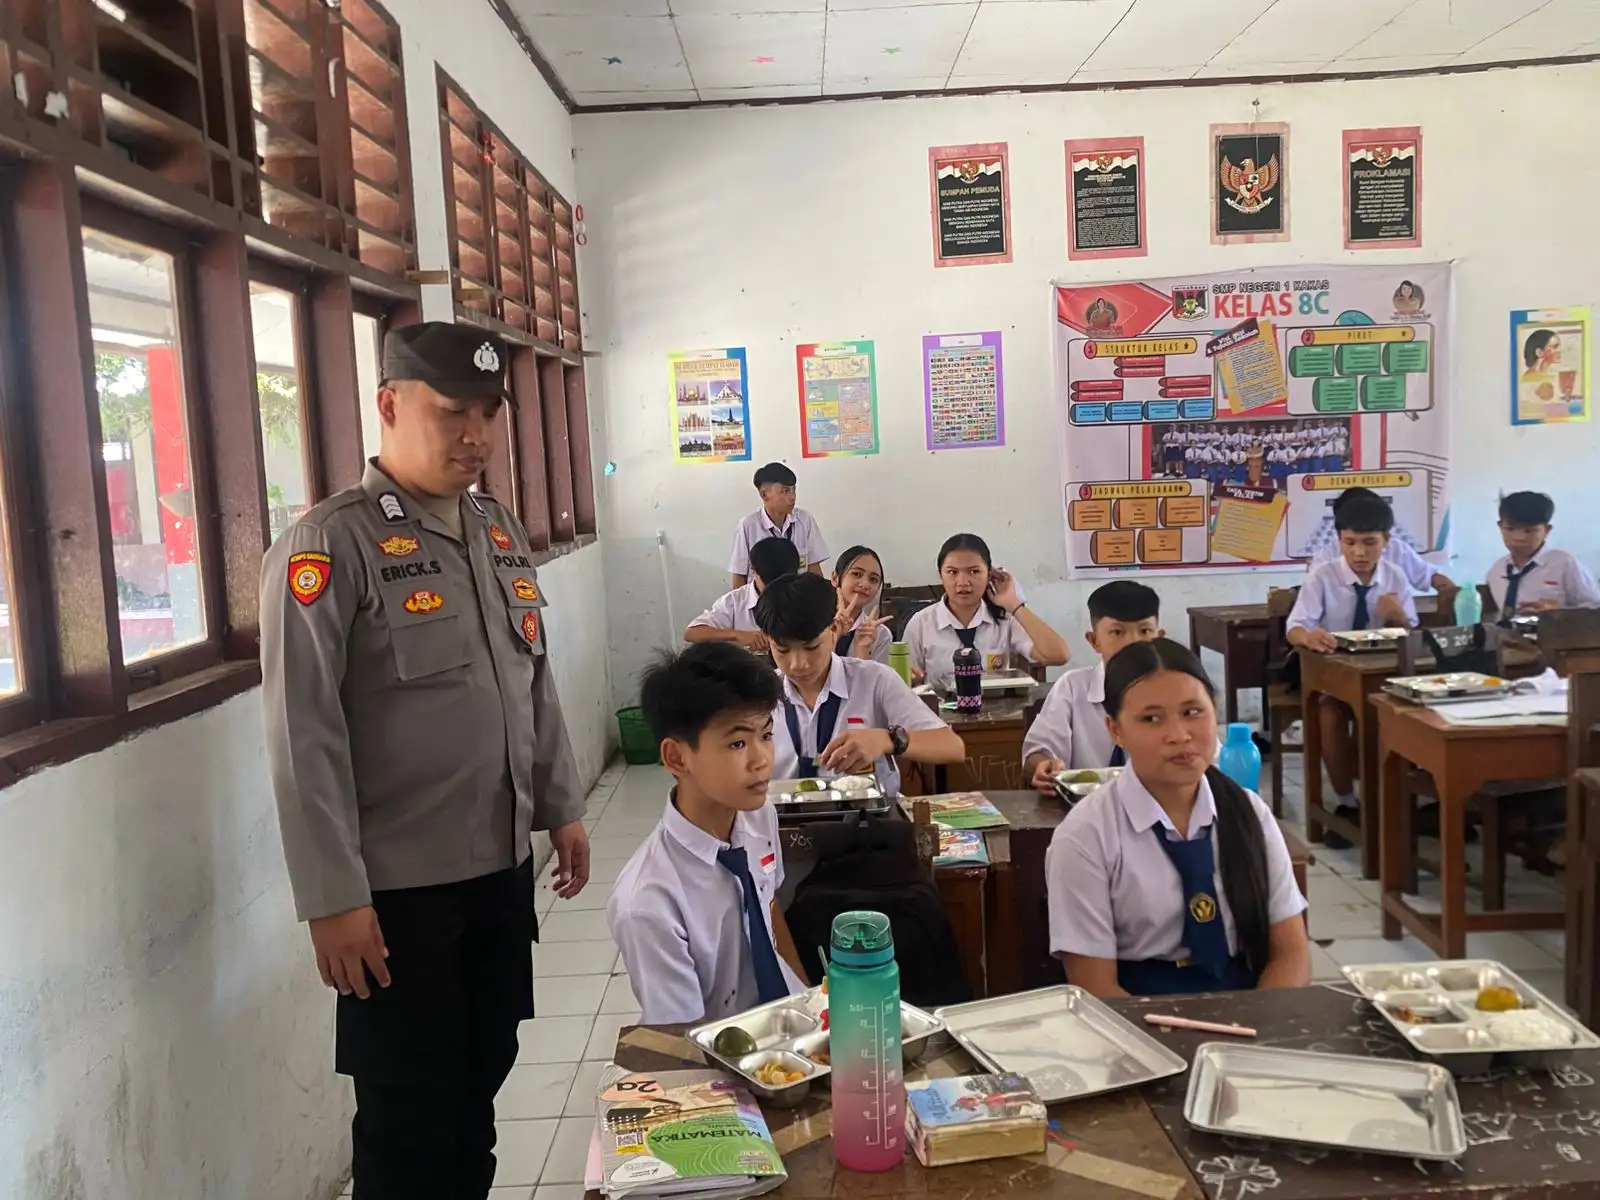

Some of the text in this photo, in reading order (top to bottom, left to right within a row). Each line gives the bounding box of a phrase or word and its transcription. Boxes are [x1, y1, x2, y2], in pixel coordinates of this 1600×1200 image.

[1354, 168, 1411, 178] PROKLAMASI
[941, 186, 1000, 196] SUMPAH PEMUDA
[1212, 279, 1329, 294] SMP NEGERI 1 KAKAS
[1214, 291, 1329, 318] KELAS 8C
[1087, 342, 1178, 355] 1 STRUKTUR KELAS
[1094, 487, 1126, 496] JADWAL
[493, 555, 532, 569] POLRI
[380, 560, 442, 583] ERICK.S
[616, 1080, 657, 1092] 2a
[650, 1130, 763, 1143] MATEMATIKA
